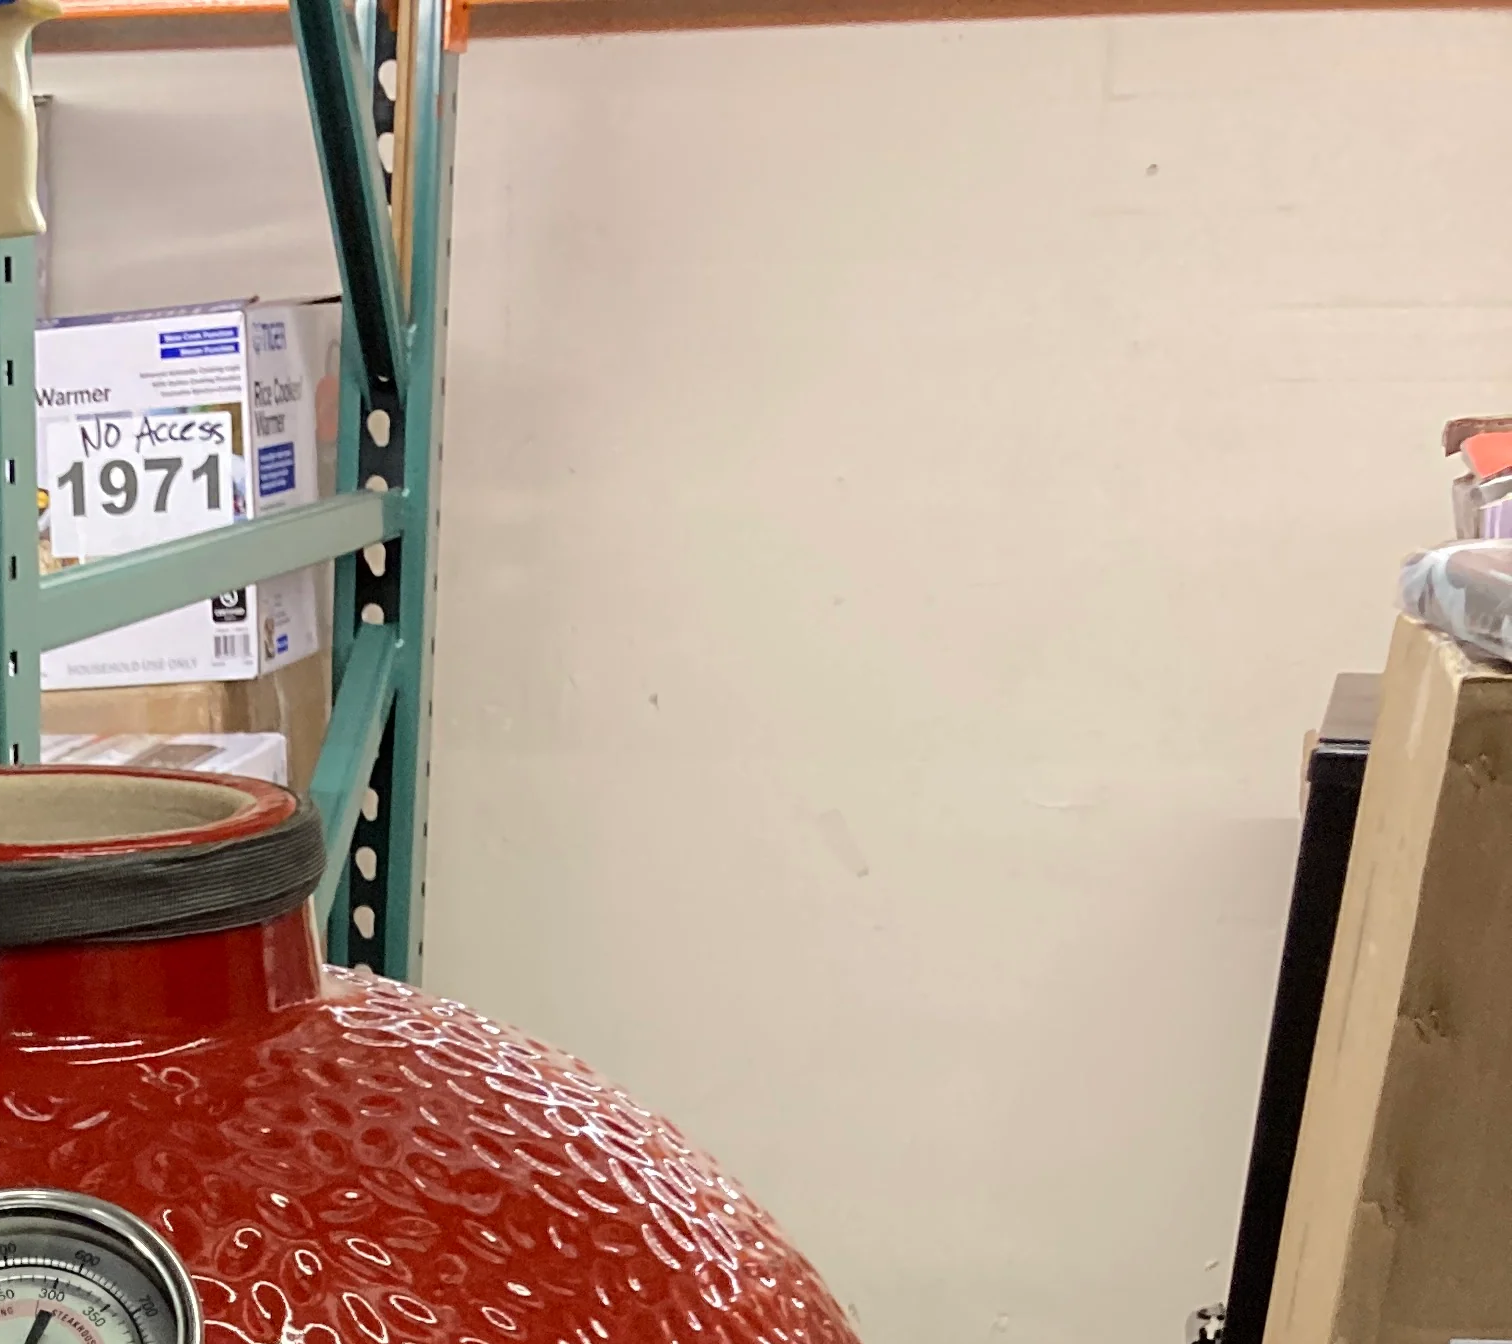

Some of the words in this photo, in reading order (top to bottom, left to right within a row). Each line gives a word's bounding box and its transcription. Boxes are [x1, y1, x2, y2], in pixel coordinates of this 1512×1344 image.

[35, 386, 112, 407] Warmer
[80, 416, 122, 458] NO
[56, 453, 222, 518] 1971
[74, 1249, 101, 1267] 600
[38, 1287, 65, 1302] 300
[82, 1305, 107, 1328] 350
